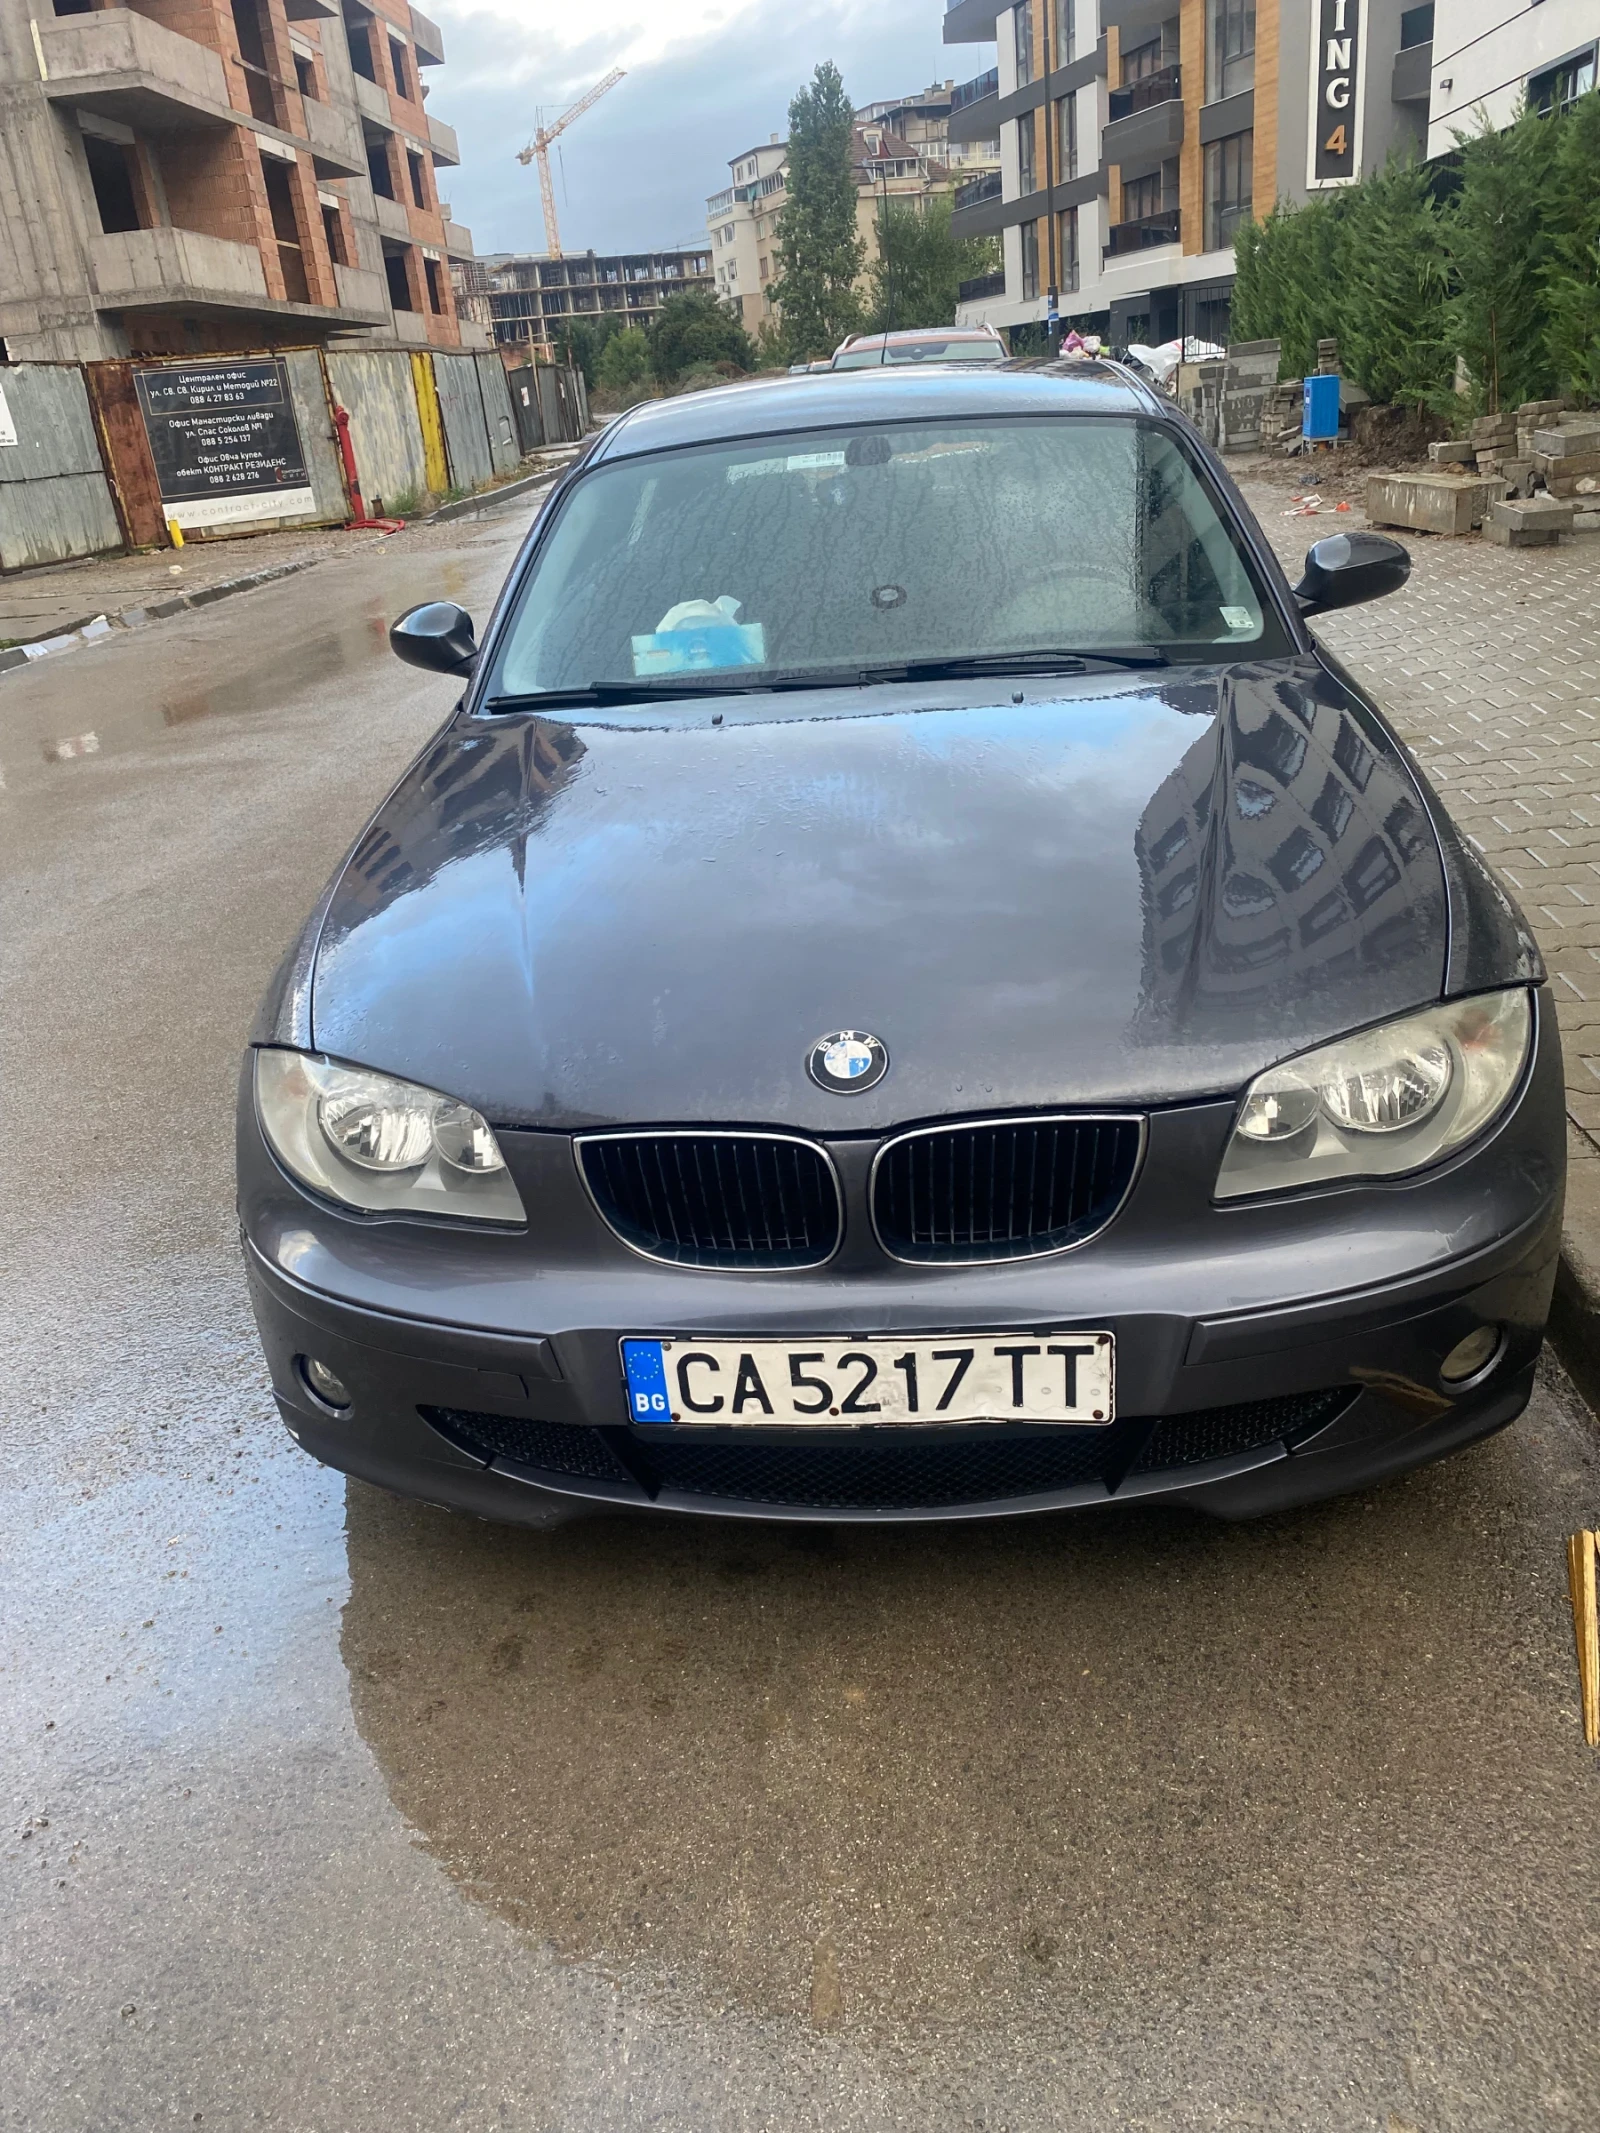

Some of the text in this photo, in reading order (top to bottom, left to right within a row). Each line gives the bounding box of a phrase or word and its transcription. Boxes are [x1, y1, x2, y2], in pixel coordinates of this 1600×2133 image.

[1325, 125, 1347, 155] 4
[179, 371, 247, 384] Централен офис
[150, 390, 162, 398] ул.
[190, 384, 216, 394] Кирил
[223, 379, 260, 391] Методий
[190, 392, 245, 404] 088 4 27 83 63
[168, 411, 274, 429] Офис Манастирски ливади
[185, 430, 196, 438] ул.
[197, 427, 217, 437] Спас
[218, 424, 250, 434] Соколов
[201, 433, 251, 447] 088 5 254 137
[176, 457, 287, 477] обект КОНТРАКТ РЕЗИДЕНС
[197, 451, 263, 465] Офис Овча купел
[209, 471, 260, 484] 088 2 628 276
[168, 496, 313, 518] www.contract-city.com
[818, 1031, 879, 1052] BMW
[676, 1344, 1095, 1414] CA 5217 TT
[635, 1392, 666, 1412] BG
